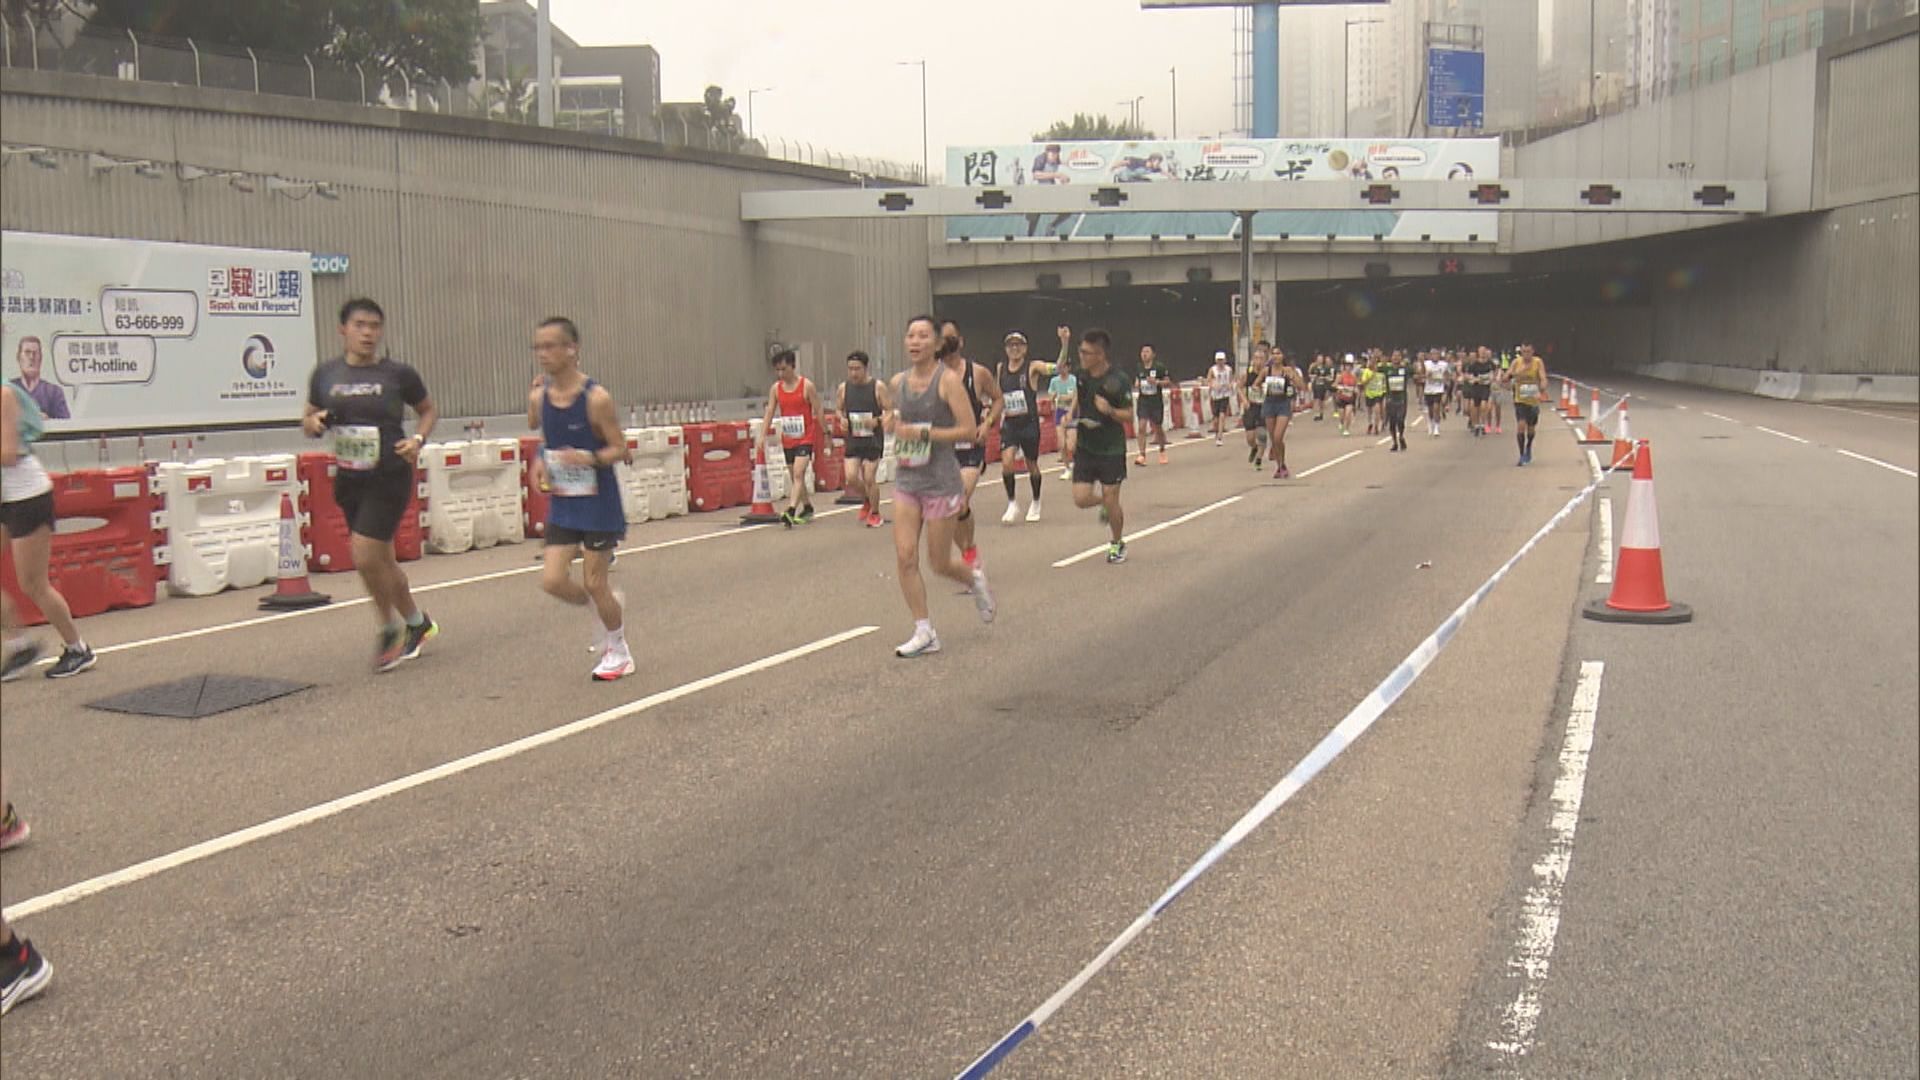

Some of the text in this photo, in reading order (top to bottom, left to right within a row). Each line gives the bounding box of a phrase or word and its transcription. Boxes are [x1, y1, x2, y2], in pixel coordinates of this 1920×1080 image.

[208, 267, 300, 298] 見疑即報
[209, 300, 297, 312] Spot and Report
[115, 314, 184, 330] 63-666-999
[68, 358, 137, 373] CT-hotline
